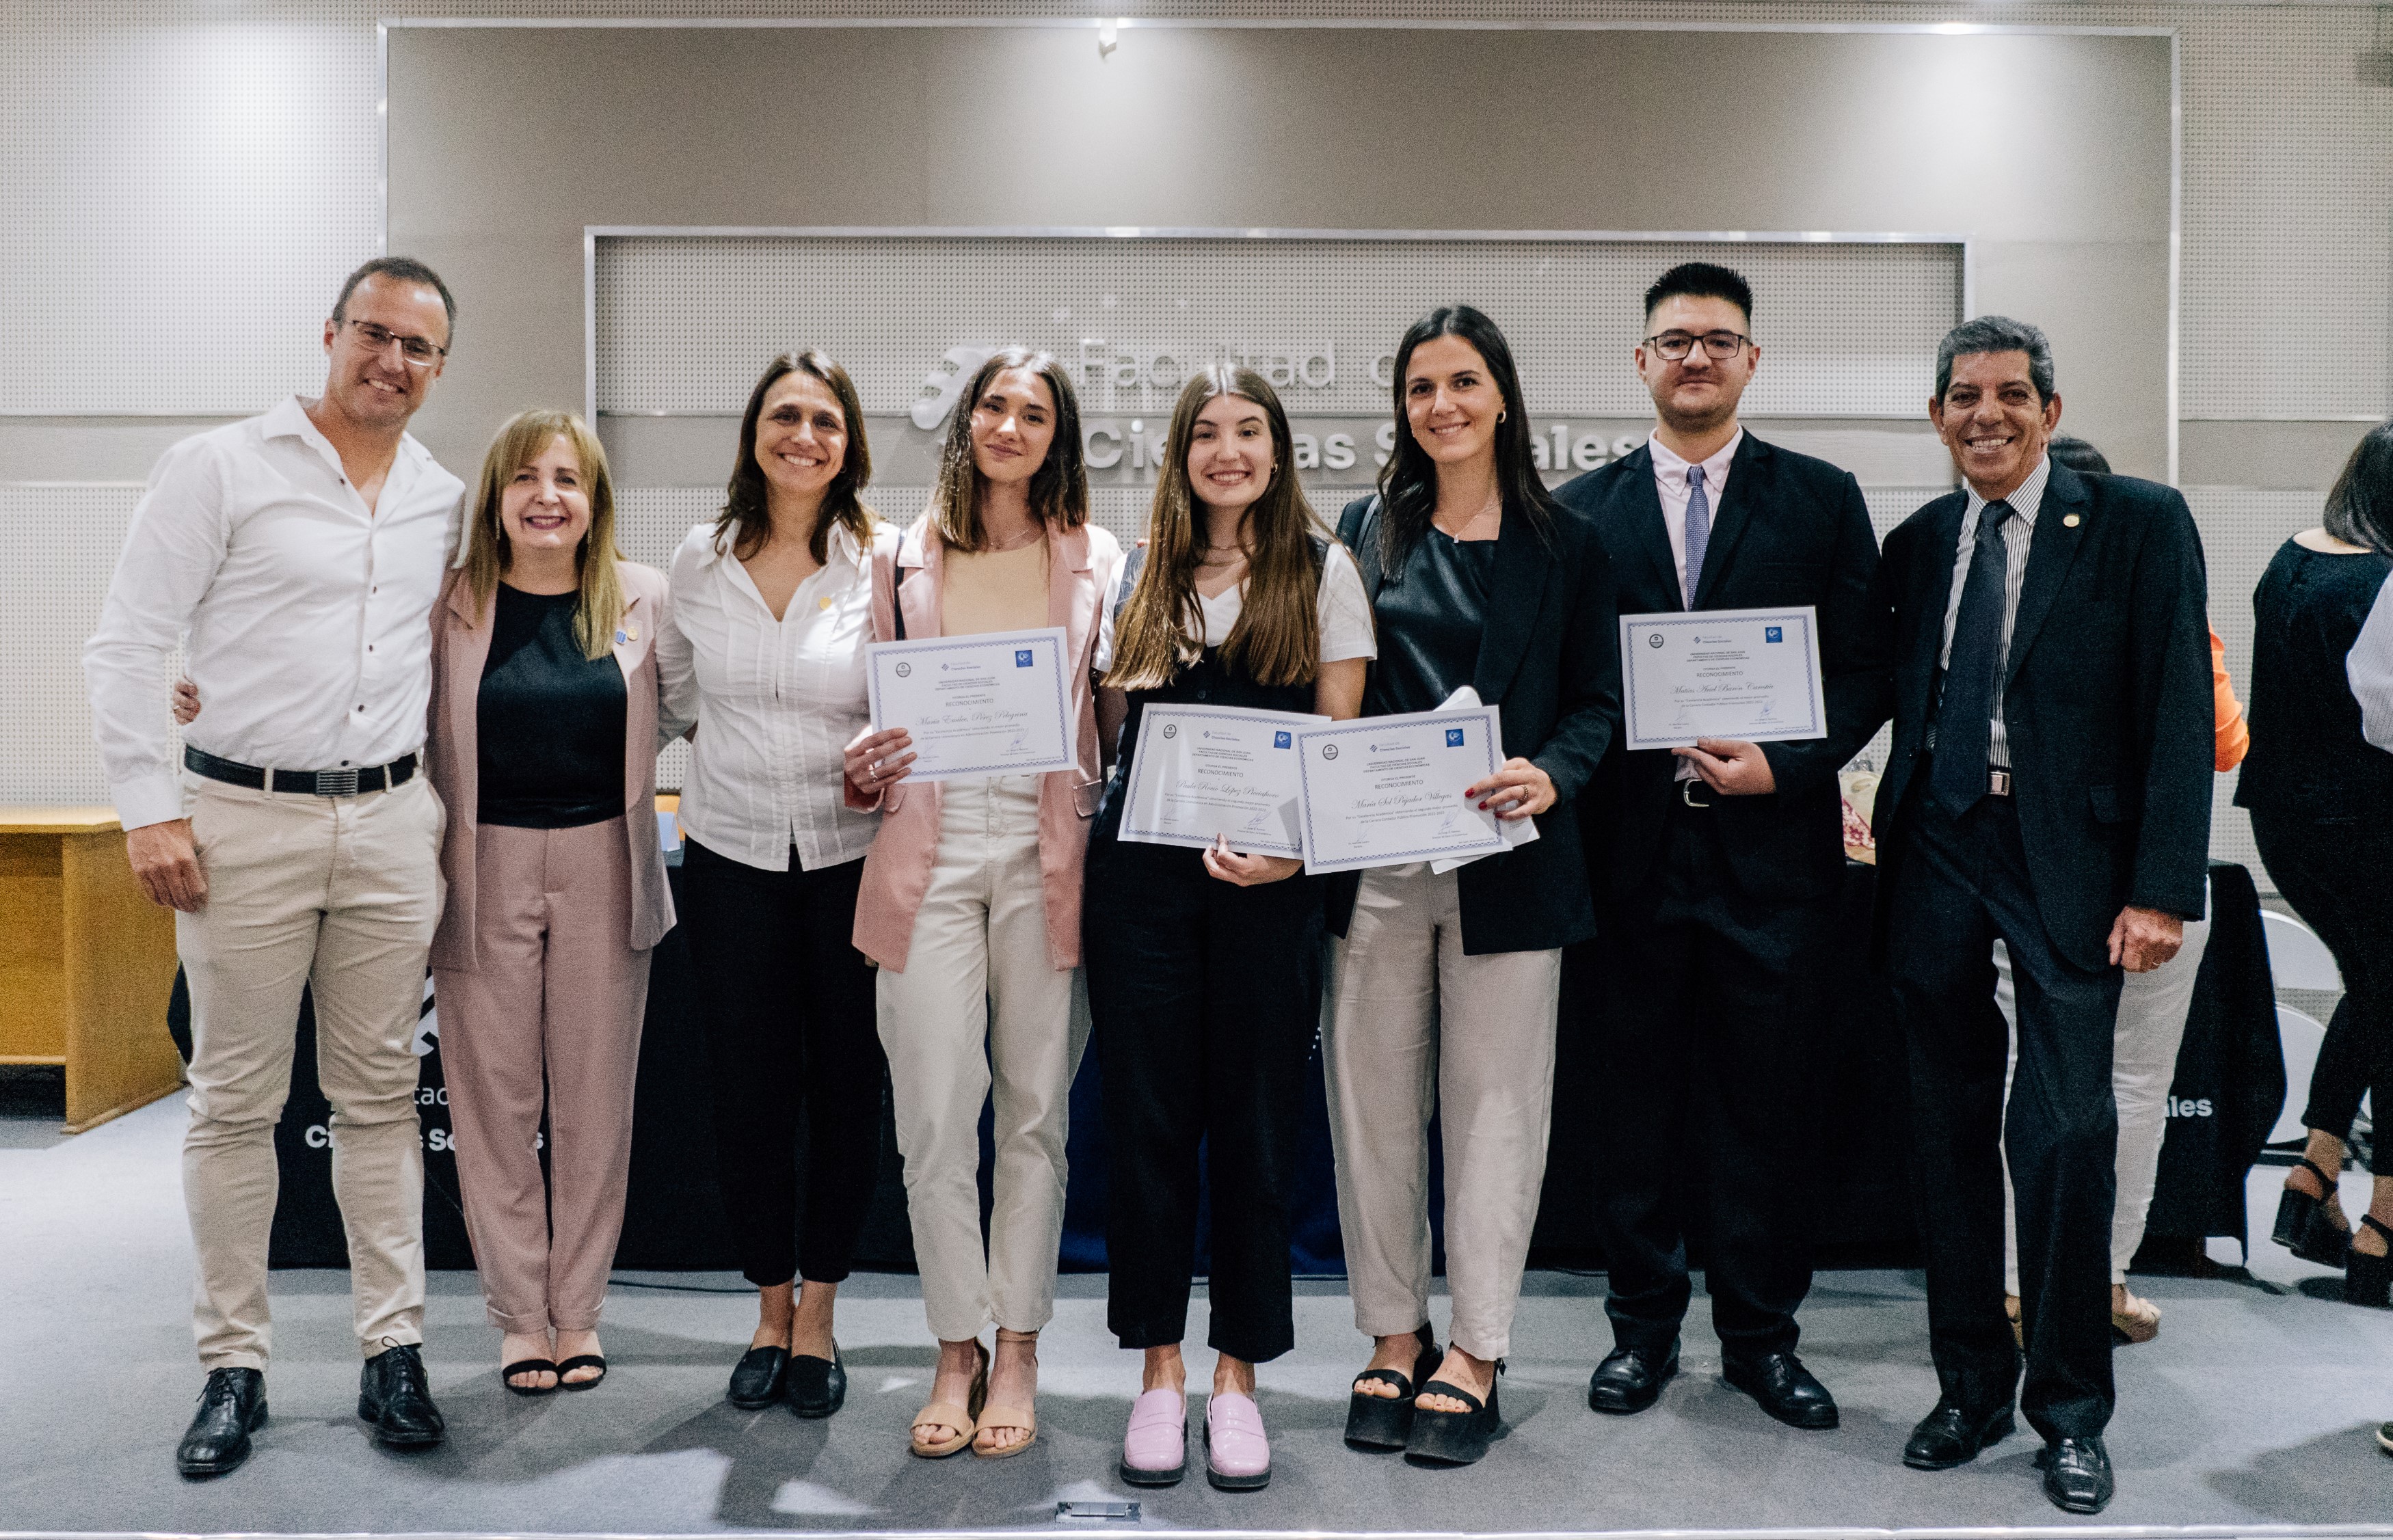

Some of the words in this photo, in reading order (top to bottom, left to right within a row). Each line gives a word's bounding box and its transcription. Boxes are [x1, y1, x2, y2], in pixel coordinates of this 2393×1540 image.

[946, 699, 994, 707] RECONOCIMIENTO
[1197, 768, 1244, 778] RECONOCIMIENTO
[1374, 780, 1423, 789] RECONOCIMIENTO
[1378, 796, 1393, 807] Sol
[1425, 789, 1452, 805] Villegas
